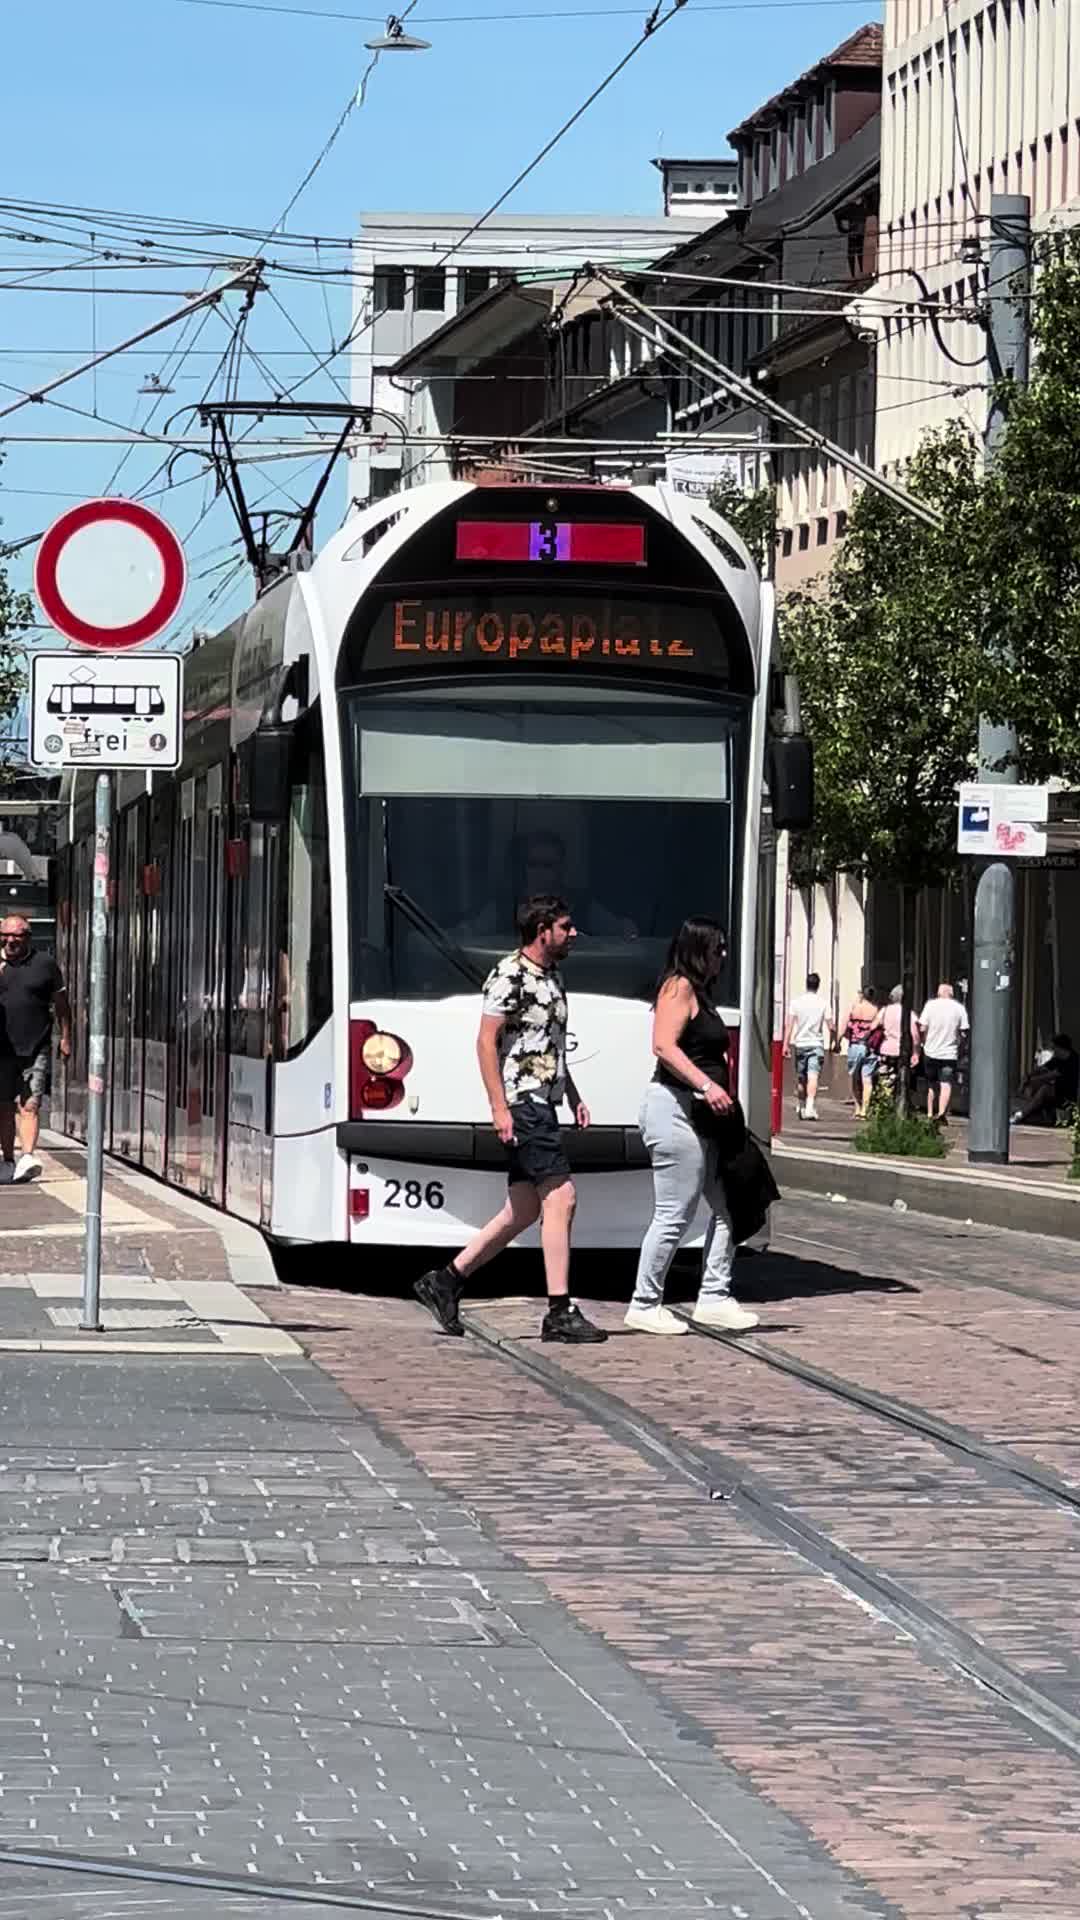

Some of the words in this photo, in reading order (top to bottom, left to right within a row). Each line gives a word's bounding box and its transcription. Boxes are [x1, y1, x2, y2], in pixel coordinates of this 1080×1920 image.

[538, 522, 557, 561] 3
[83, 728, 128, 751] frei
[383, 1178, 446, 1210] 286
